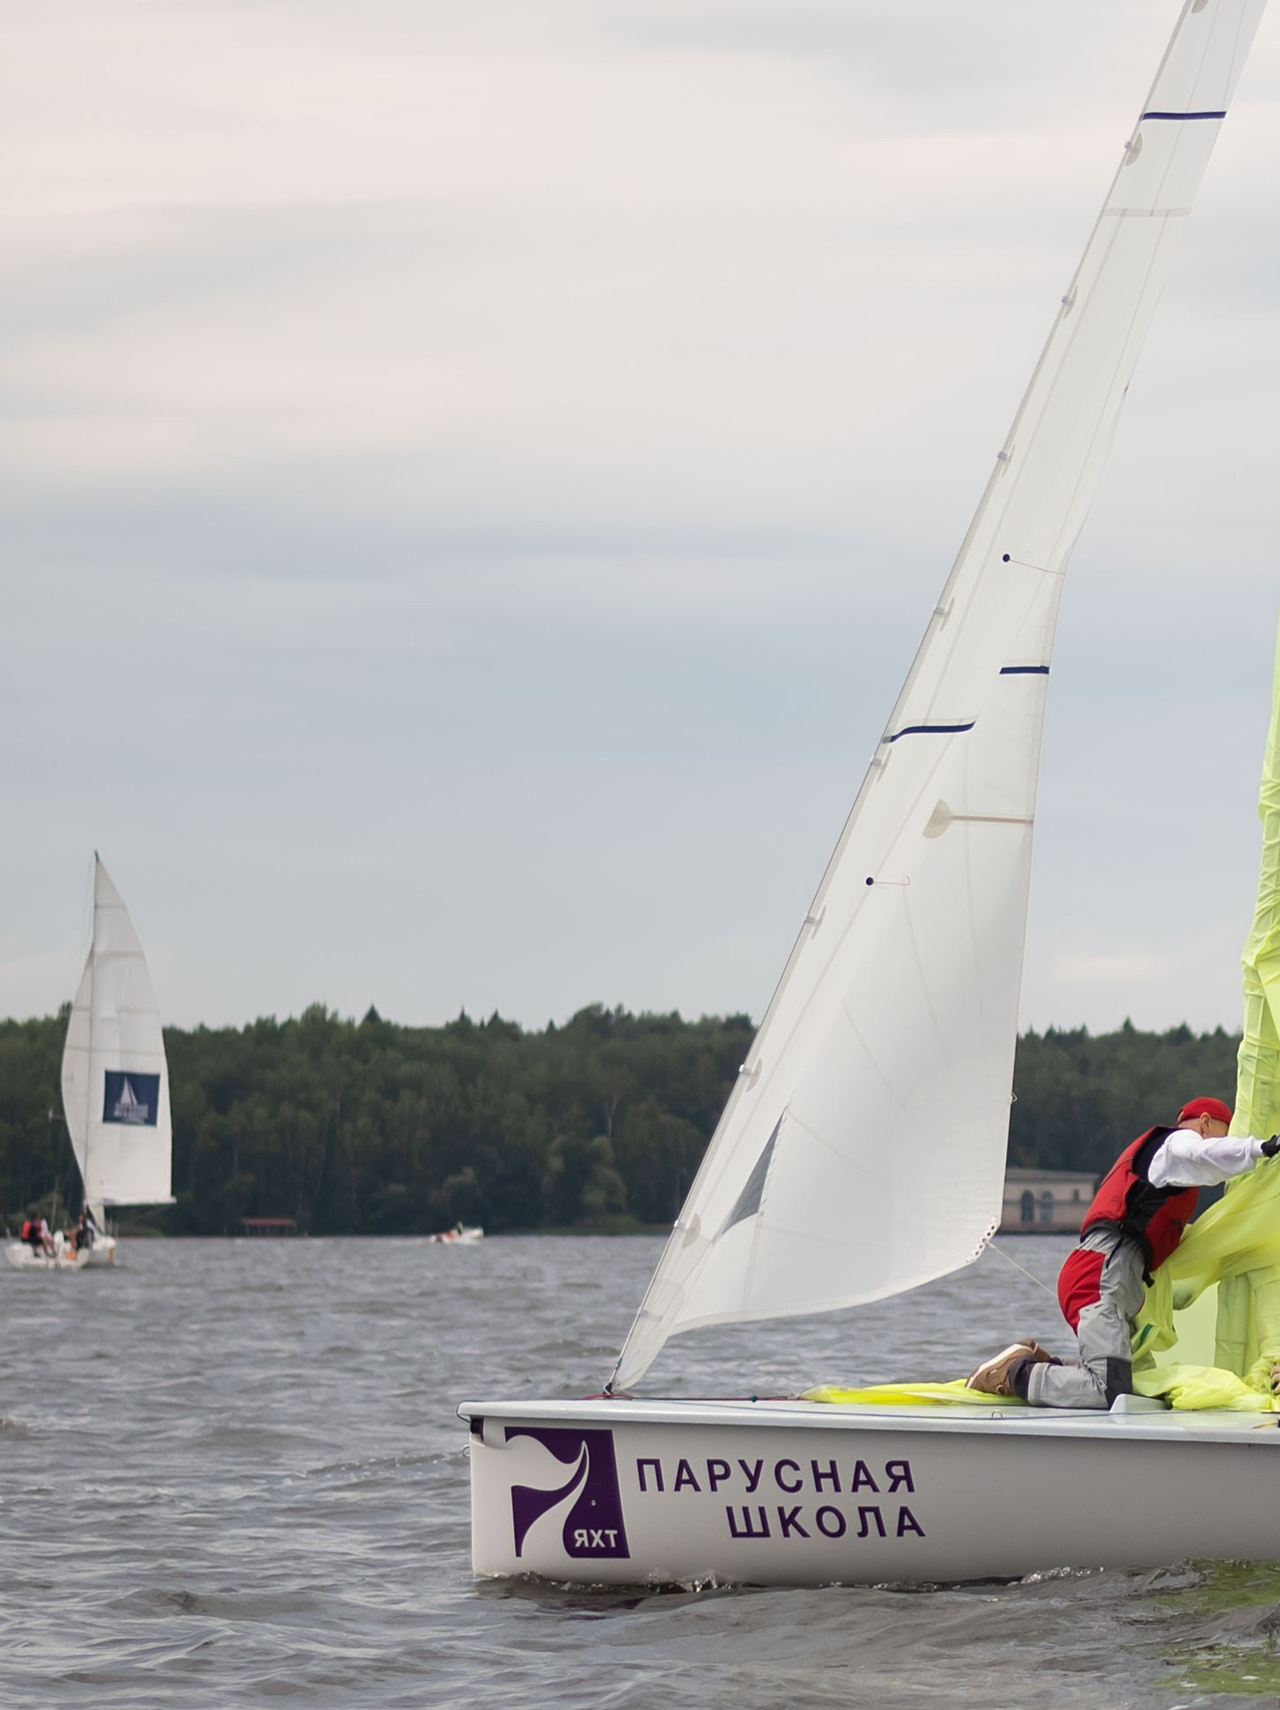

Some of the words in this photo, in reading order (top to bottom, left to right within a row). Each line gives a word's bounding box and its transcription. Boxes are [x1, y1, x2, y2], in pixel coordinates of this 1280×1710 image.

[636, 1458, 916, 1494] ПАРУСНАЯ
[574, 1529, 618, 1548] ЯХТ
[726, 1506, 927, 1539] ШКОЛА
